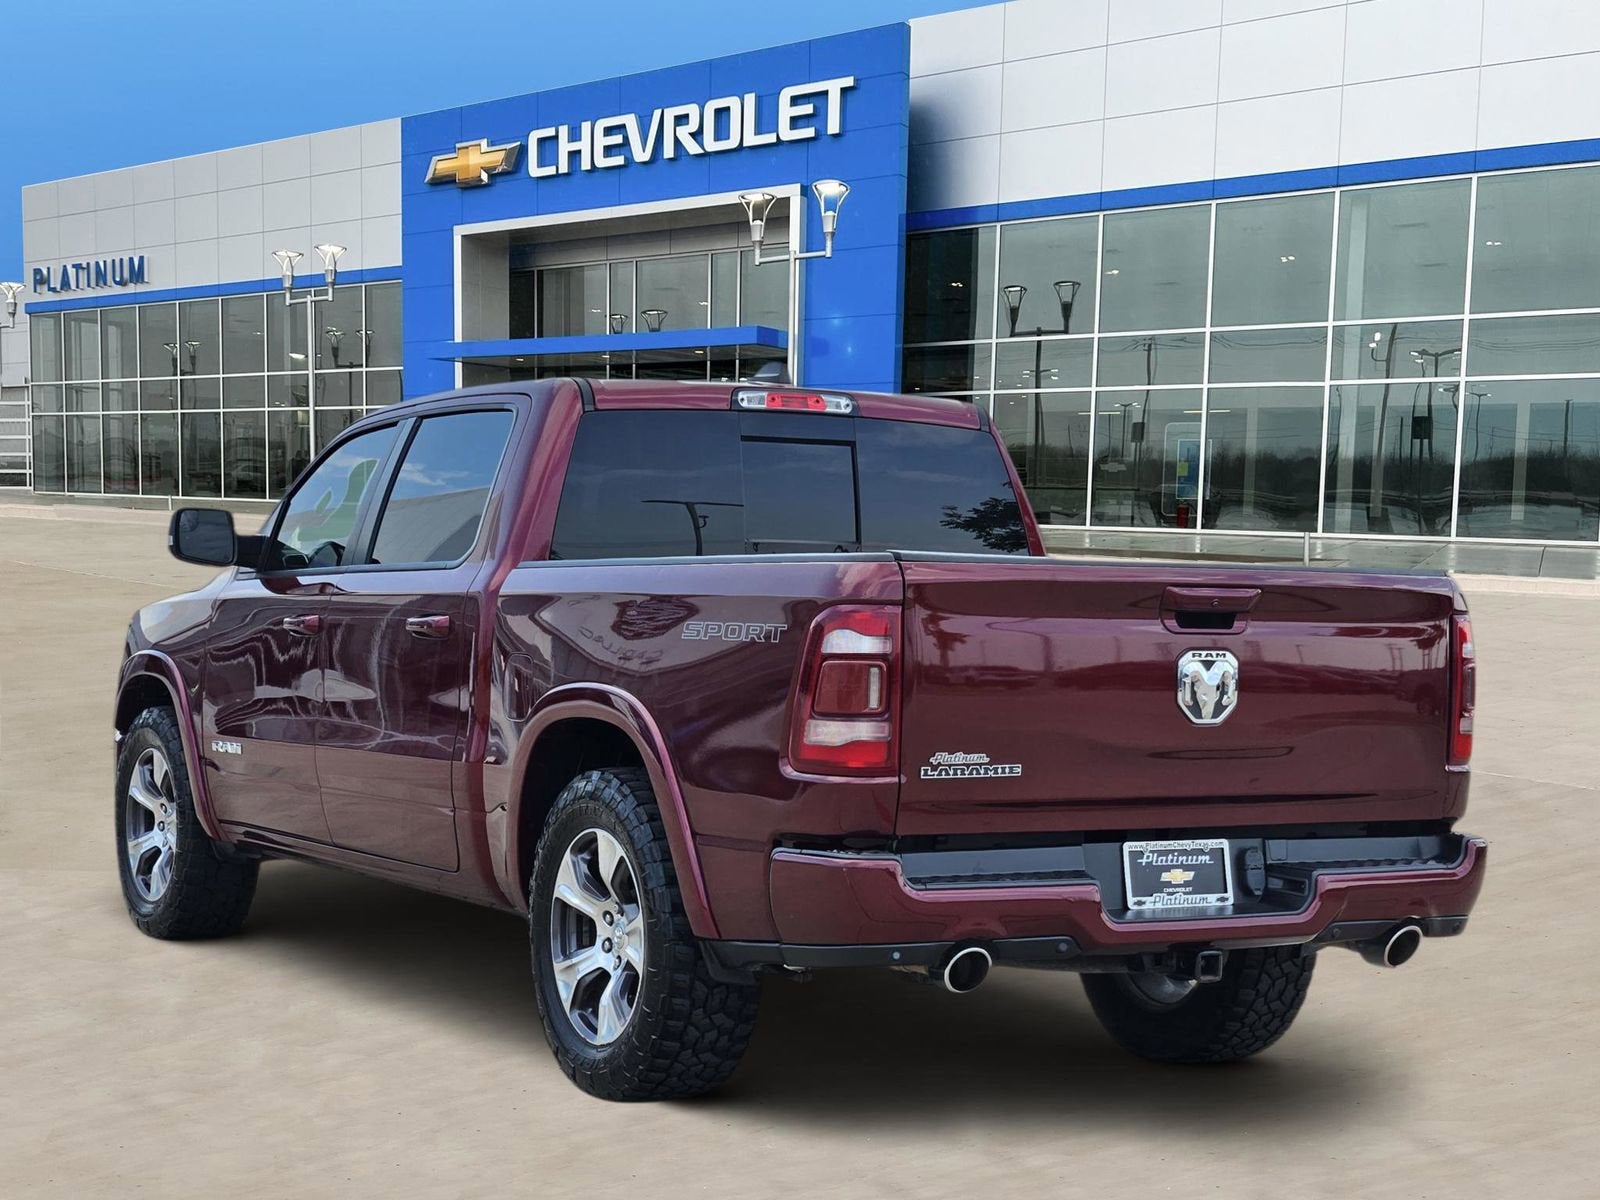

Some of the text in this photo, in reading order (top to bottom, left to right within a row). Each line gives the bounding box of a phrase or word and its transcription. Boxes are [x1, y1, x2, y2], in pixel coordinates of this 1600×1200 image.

[527, 75, 856, 177] CHEVROLET
[33, 255, 146, 294] PLATINUM
[681, 621, 787, 643] SPORT
[929, 752, 990, 765] Platinum
[920, 764, 1022, 778] LARAMIE
[1128, 841, 1224, 850] www.PlatinumChevyTexas.com
[1137, 852, 1214, 866] Platinum
[1148, 892, 1213, 907] Platinum
